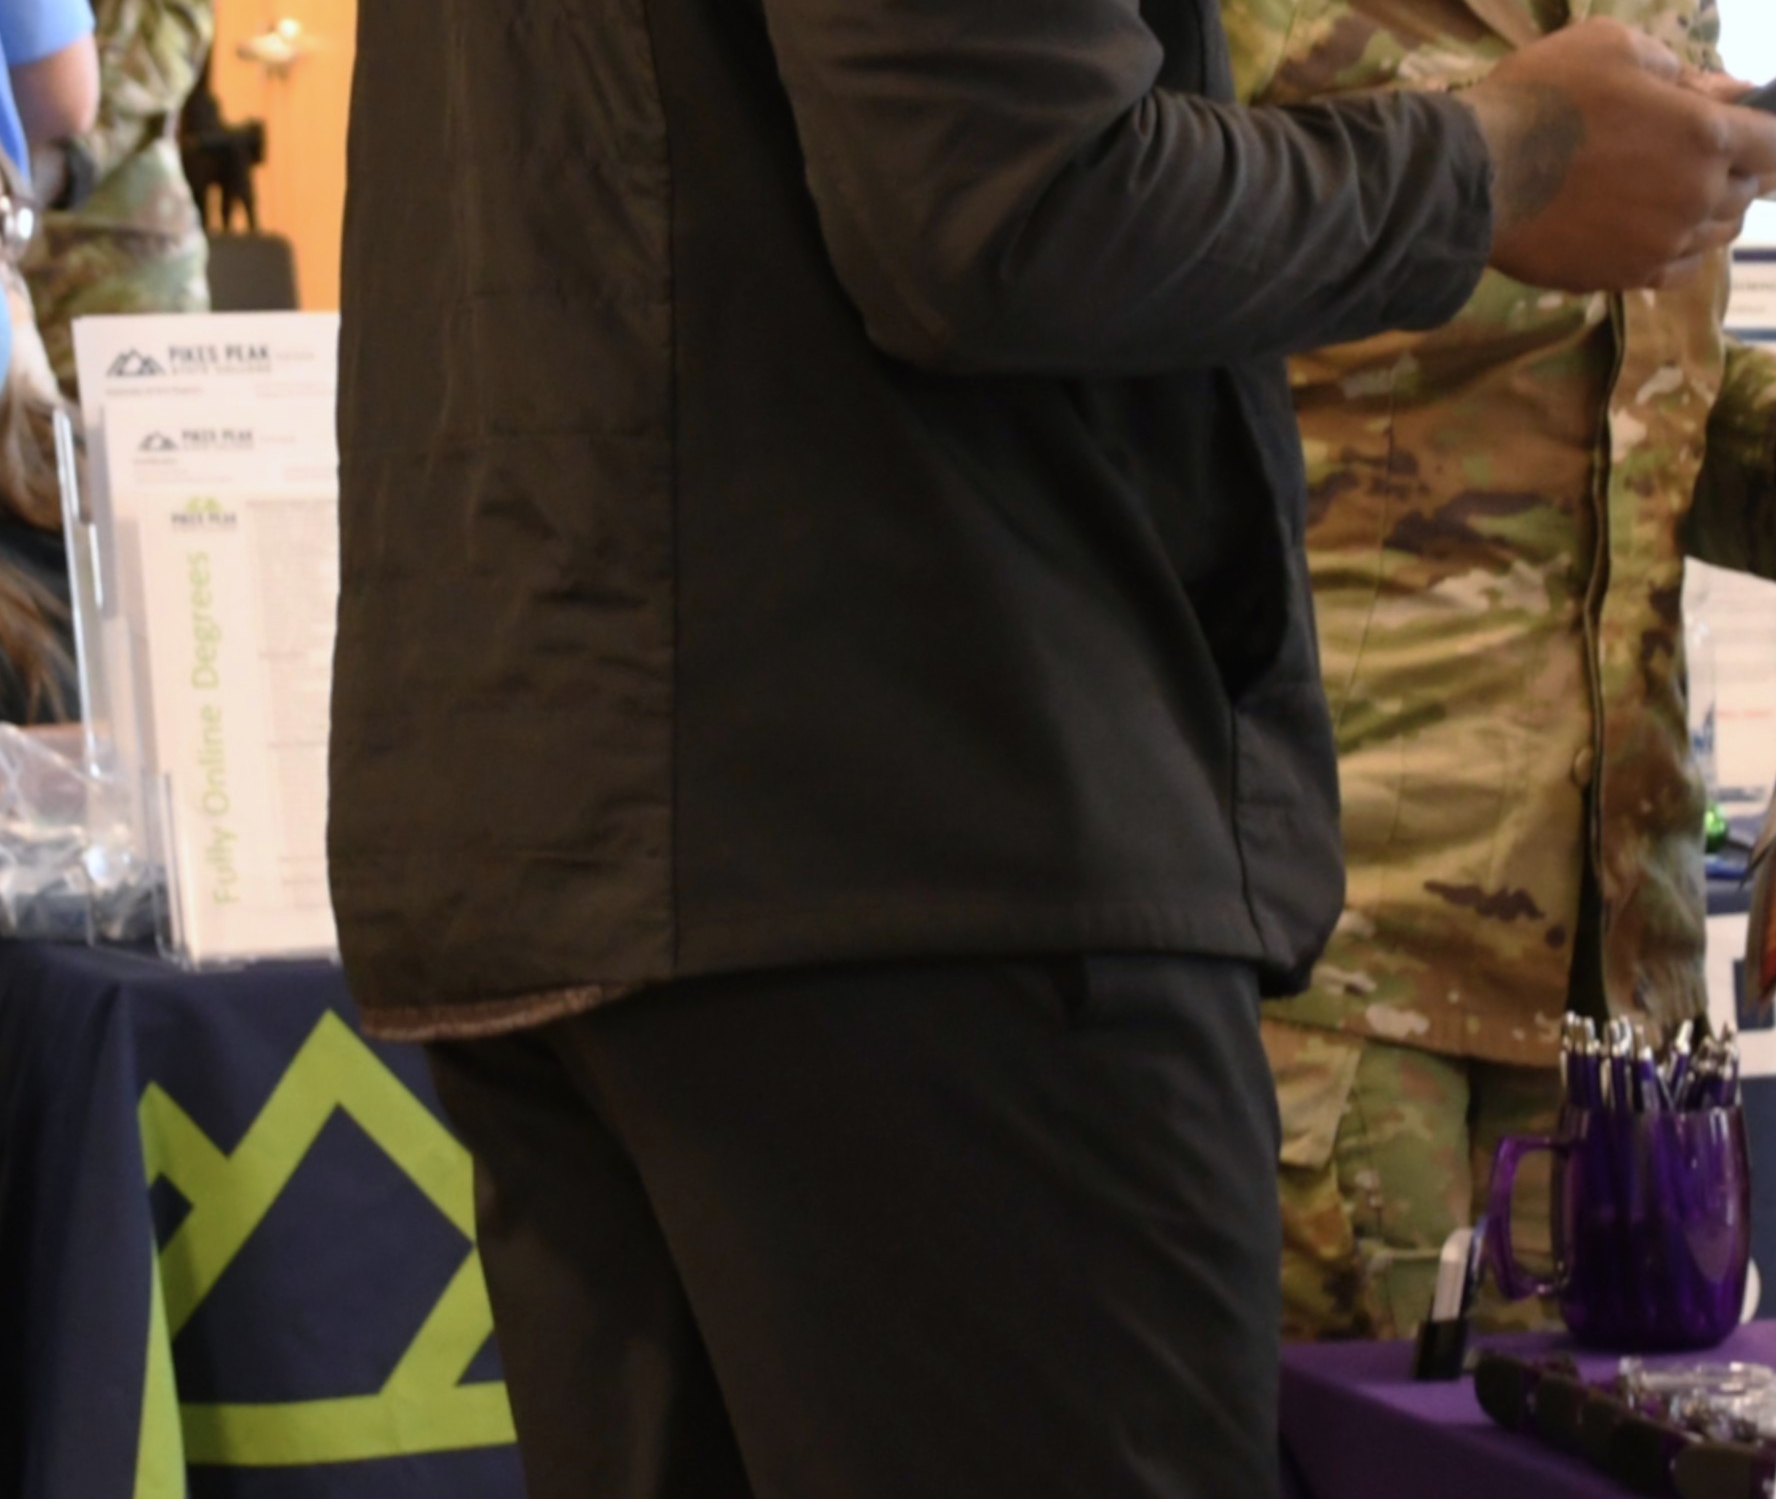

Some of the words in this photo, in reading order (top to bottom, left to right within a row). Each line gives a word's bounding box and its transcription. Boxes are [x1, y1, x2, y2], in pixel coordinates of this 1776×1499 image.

[168, 344, 219, 364] PIKES
[224, 343, 271, 363] PEAK
[187, 550, 223, 690] Degrees
[197, 703, 231, 818] Online
[204, 824, 240, 906] Fully
